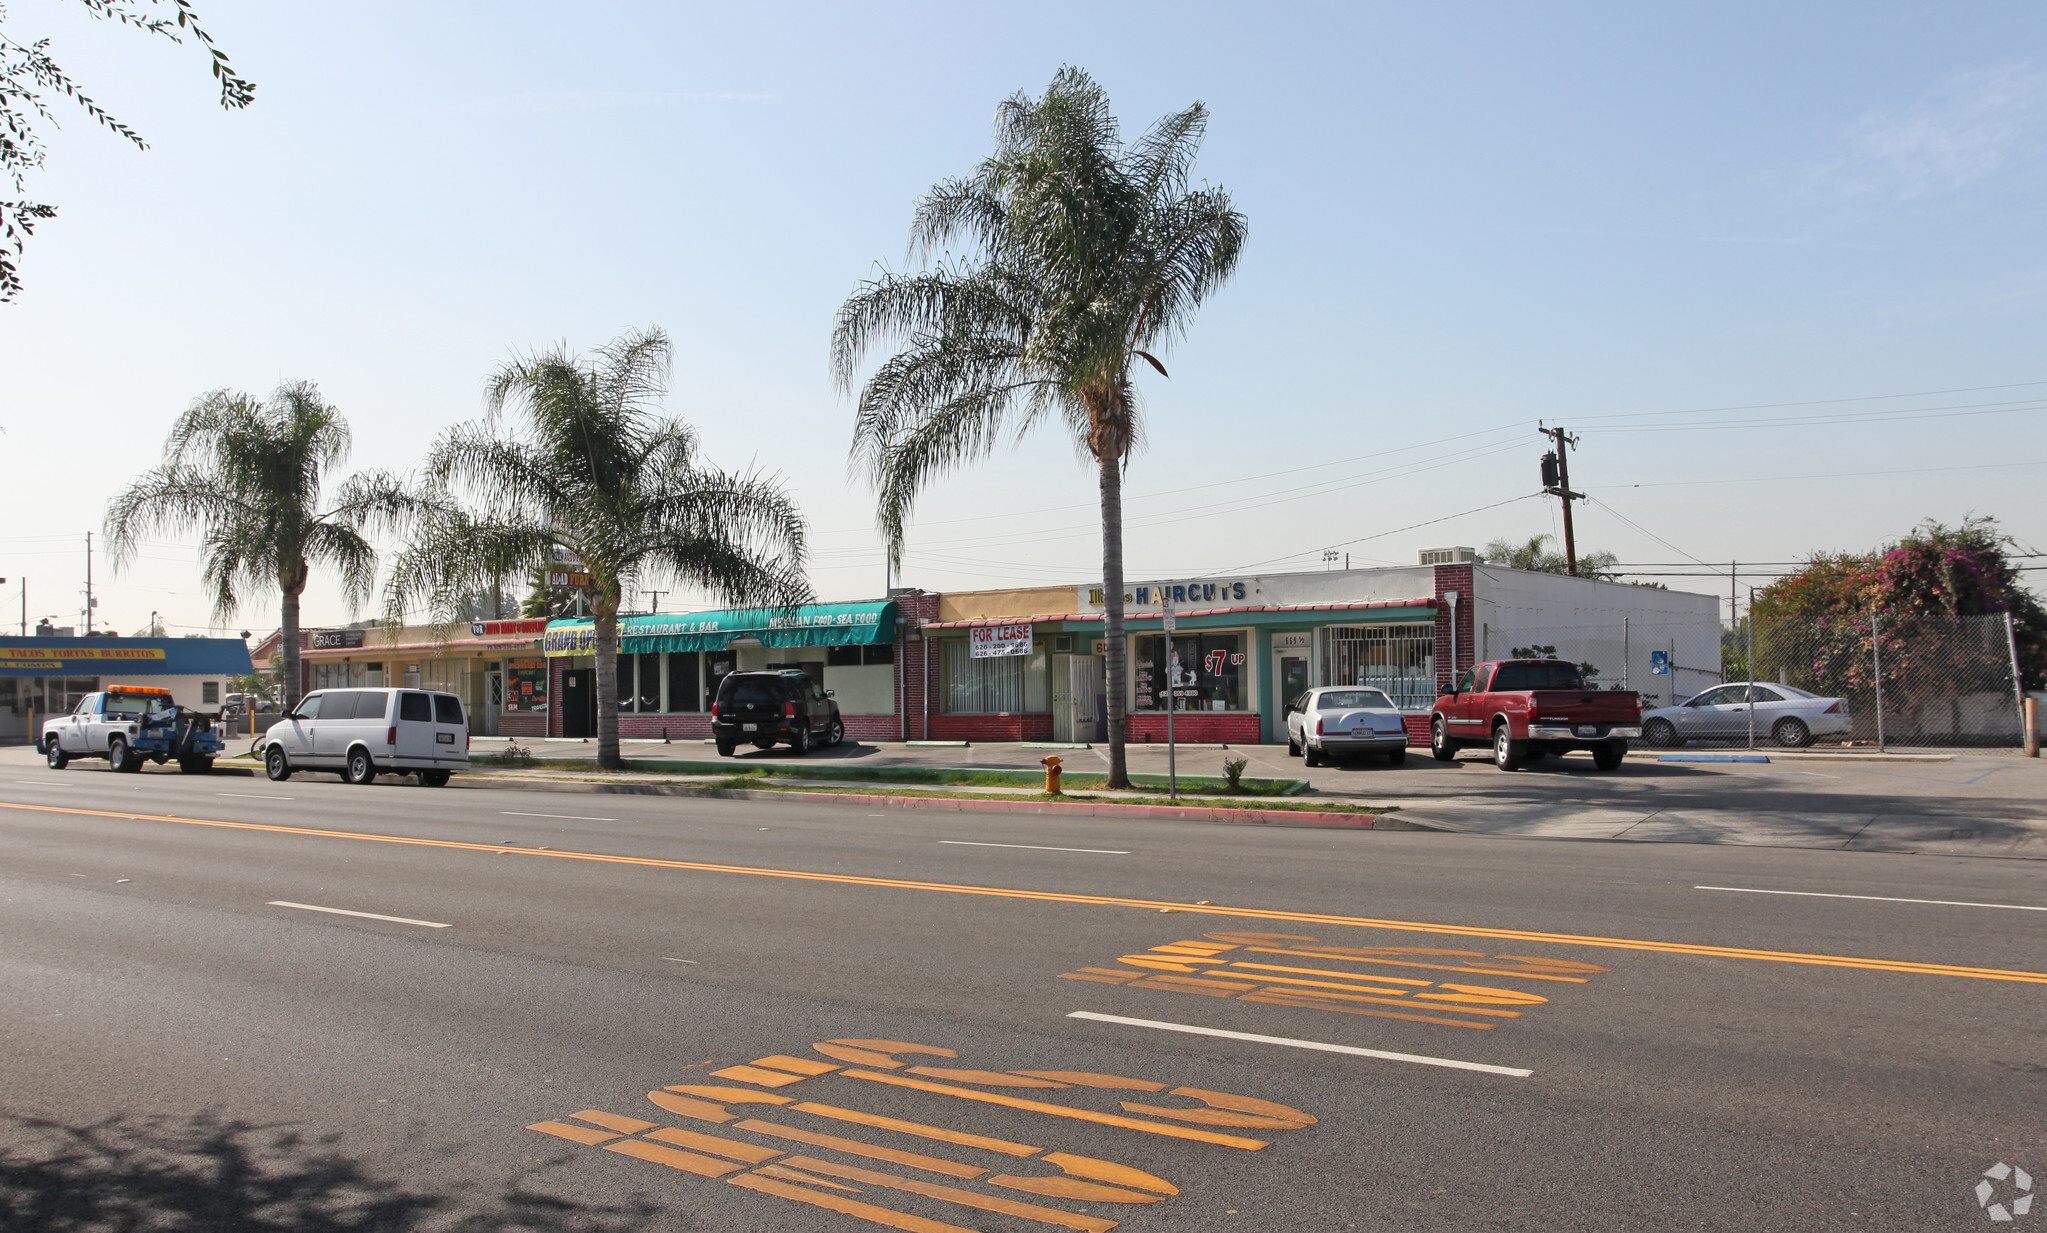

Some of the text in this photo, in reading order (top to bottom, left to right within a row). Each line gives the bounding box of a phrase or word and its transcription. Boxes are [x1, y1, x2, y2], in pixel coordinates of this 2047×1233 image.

[1136, 581, 1246, 606] HAIRCUTS
[813, 614, 833, 626] FOOD
[836, 613, 853, 625] SEA
[854, 612, 878, 624] FOOD
[486, 623, 500, 635] AUTO
[627, 621, 719, 635] RESTAURANT & BAR
[973, 625, 1030, 643] FOR LEASE
[312, 632, 342, 648] GRACE
[544, 630, 578, 652] GRAND
[8, 648, 156, 658] TACOS TORTAS BURRITOS
[1205, 649, 1227, 677] $7
[1231, 653, 1246, 666] UP
[506, 690, 519, 701] 3M
